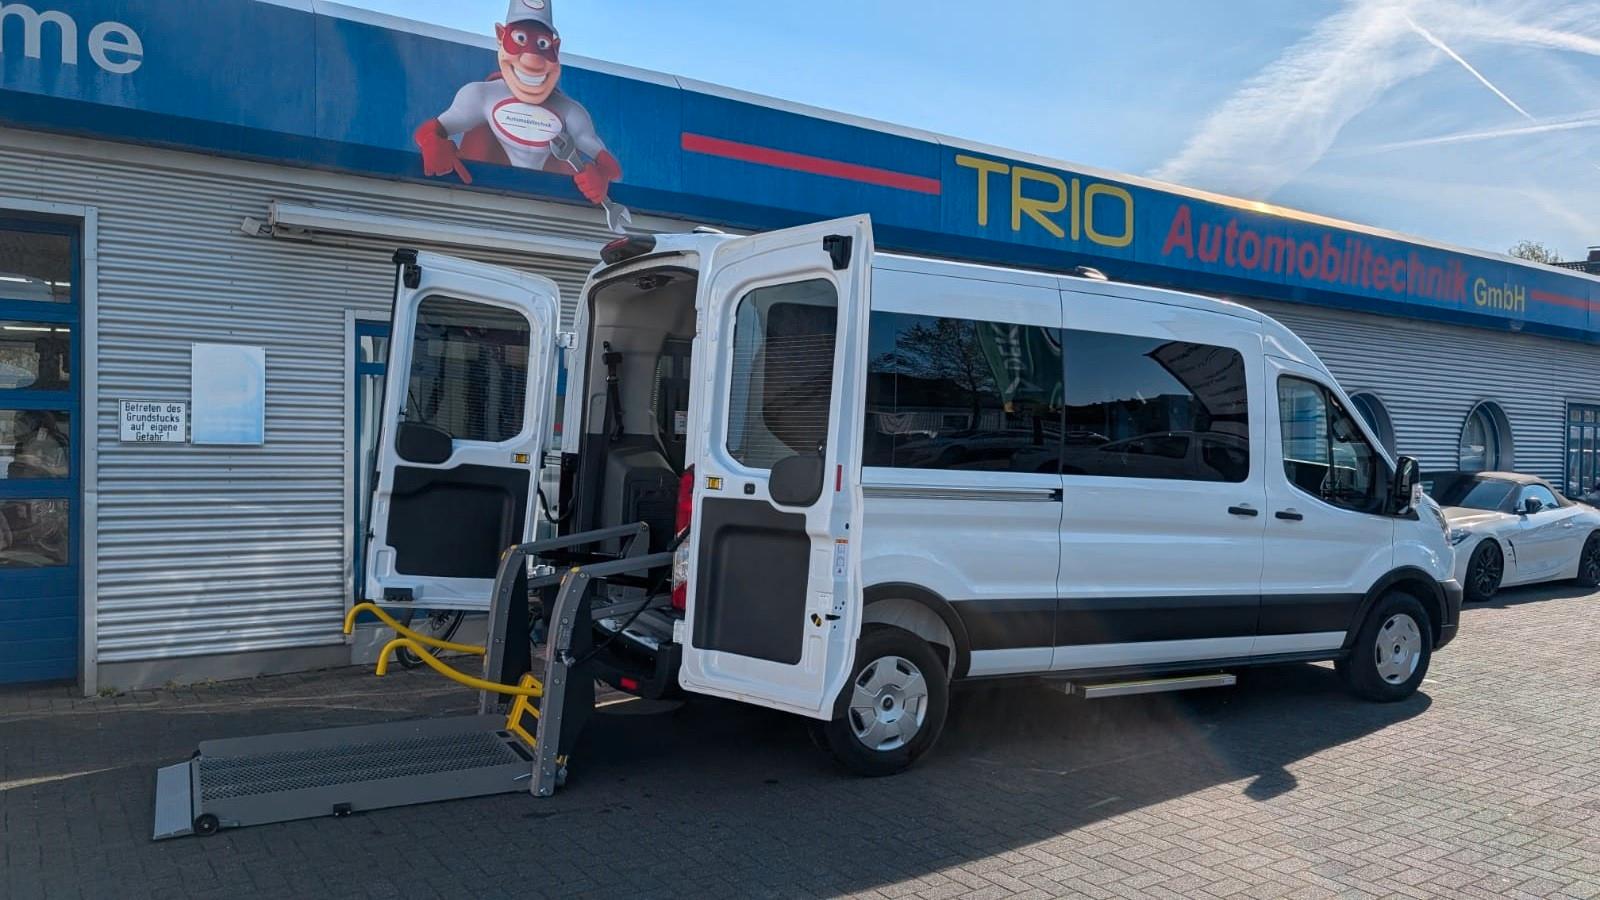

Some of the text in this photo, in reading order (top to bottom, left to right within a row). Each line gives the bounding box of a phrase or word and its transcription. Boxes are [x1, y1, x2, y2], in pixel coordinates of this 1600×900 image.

[955, 154, 1525, 313] TRIO Automobiltechnik GmbH
[125, 402, 182, 413] Betreten des
[130, 422, 178, 433] auf eigene
